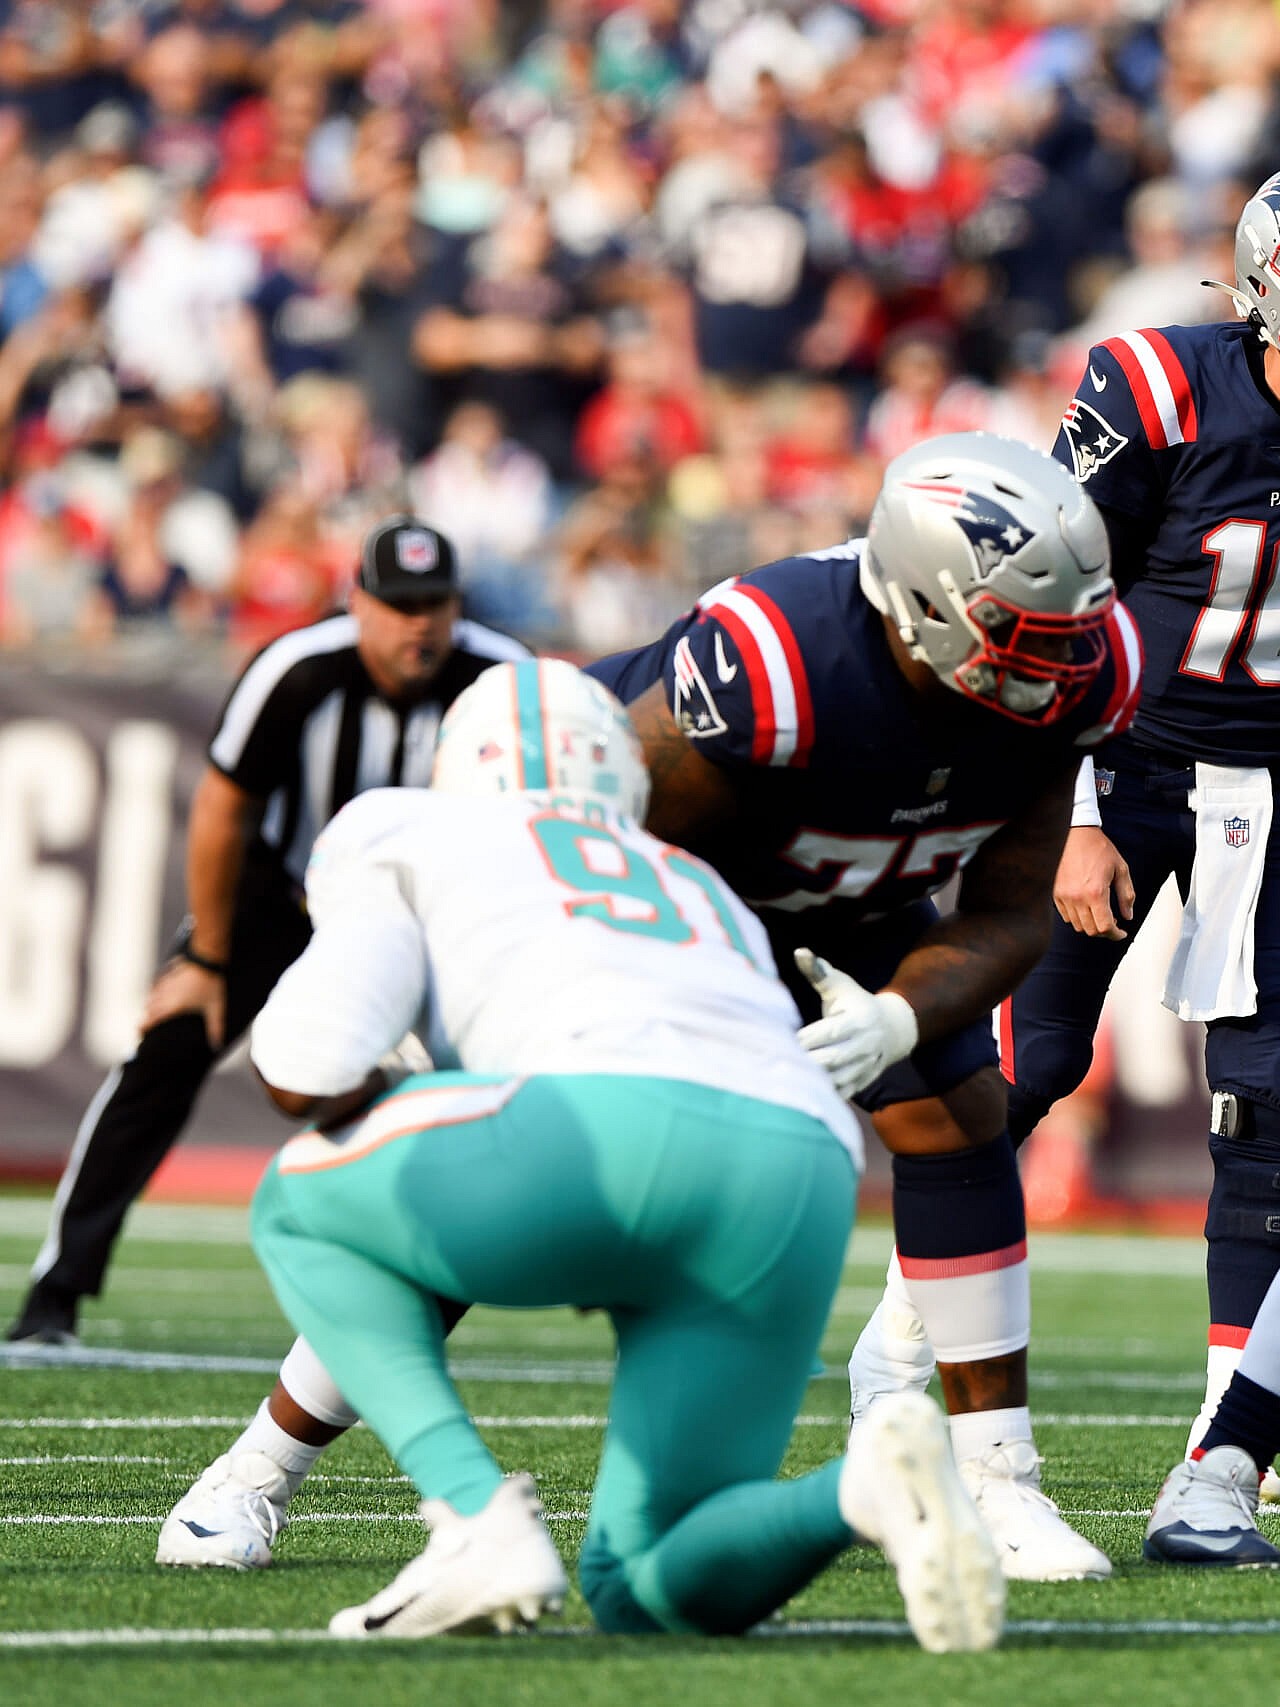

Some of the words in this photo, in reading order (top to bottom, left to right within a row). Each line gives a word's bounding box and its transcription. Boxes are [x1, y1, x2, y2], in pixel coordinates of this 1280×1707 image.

[748, 818, 1014, 913] 77
[1226, 830, 1249, 845] NFL
[528, 809, 774, 980] 91
